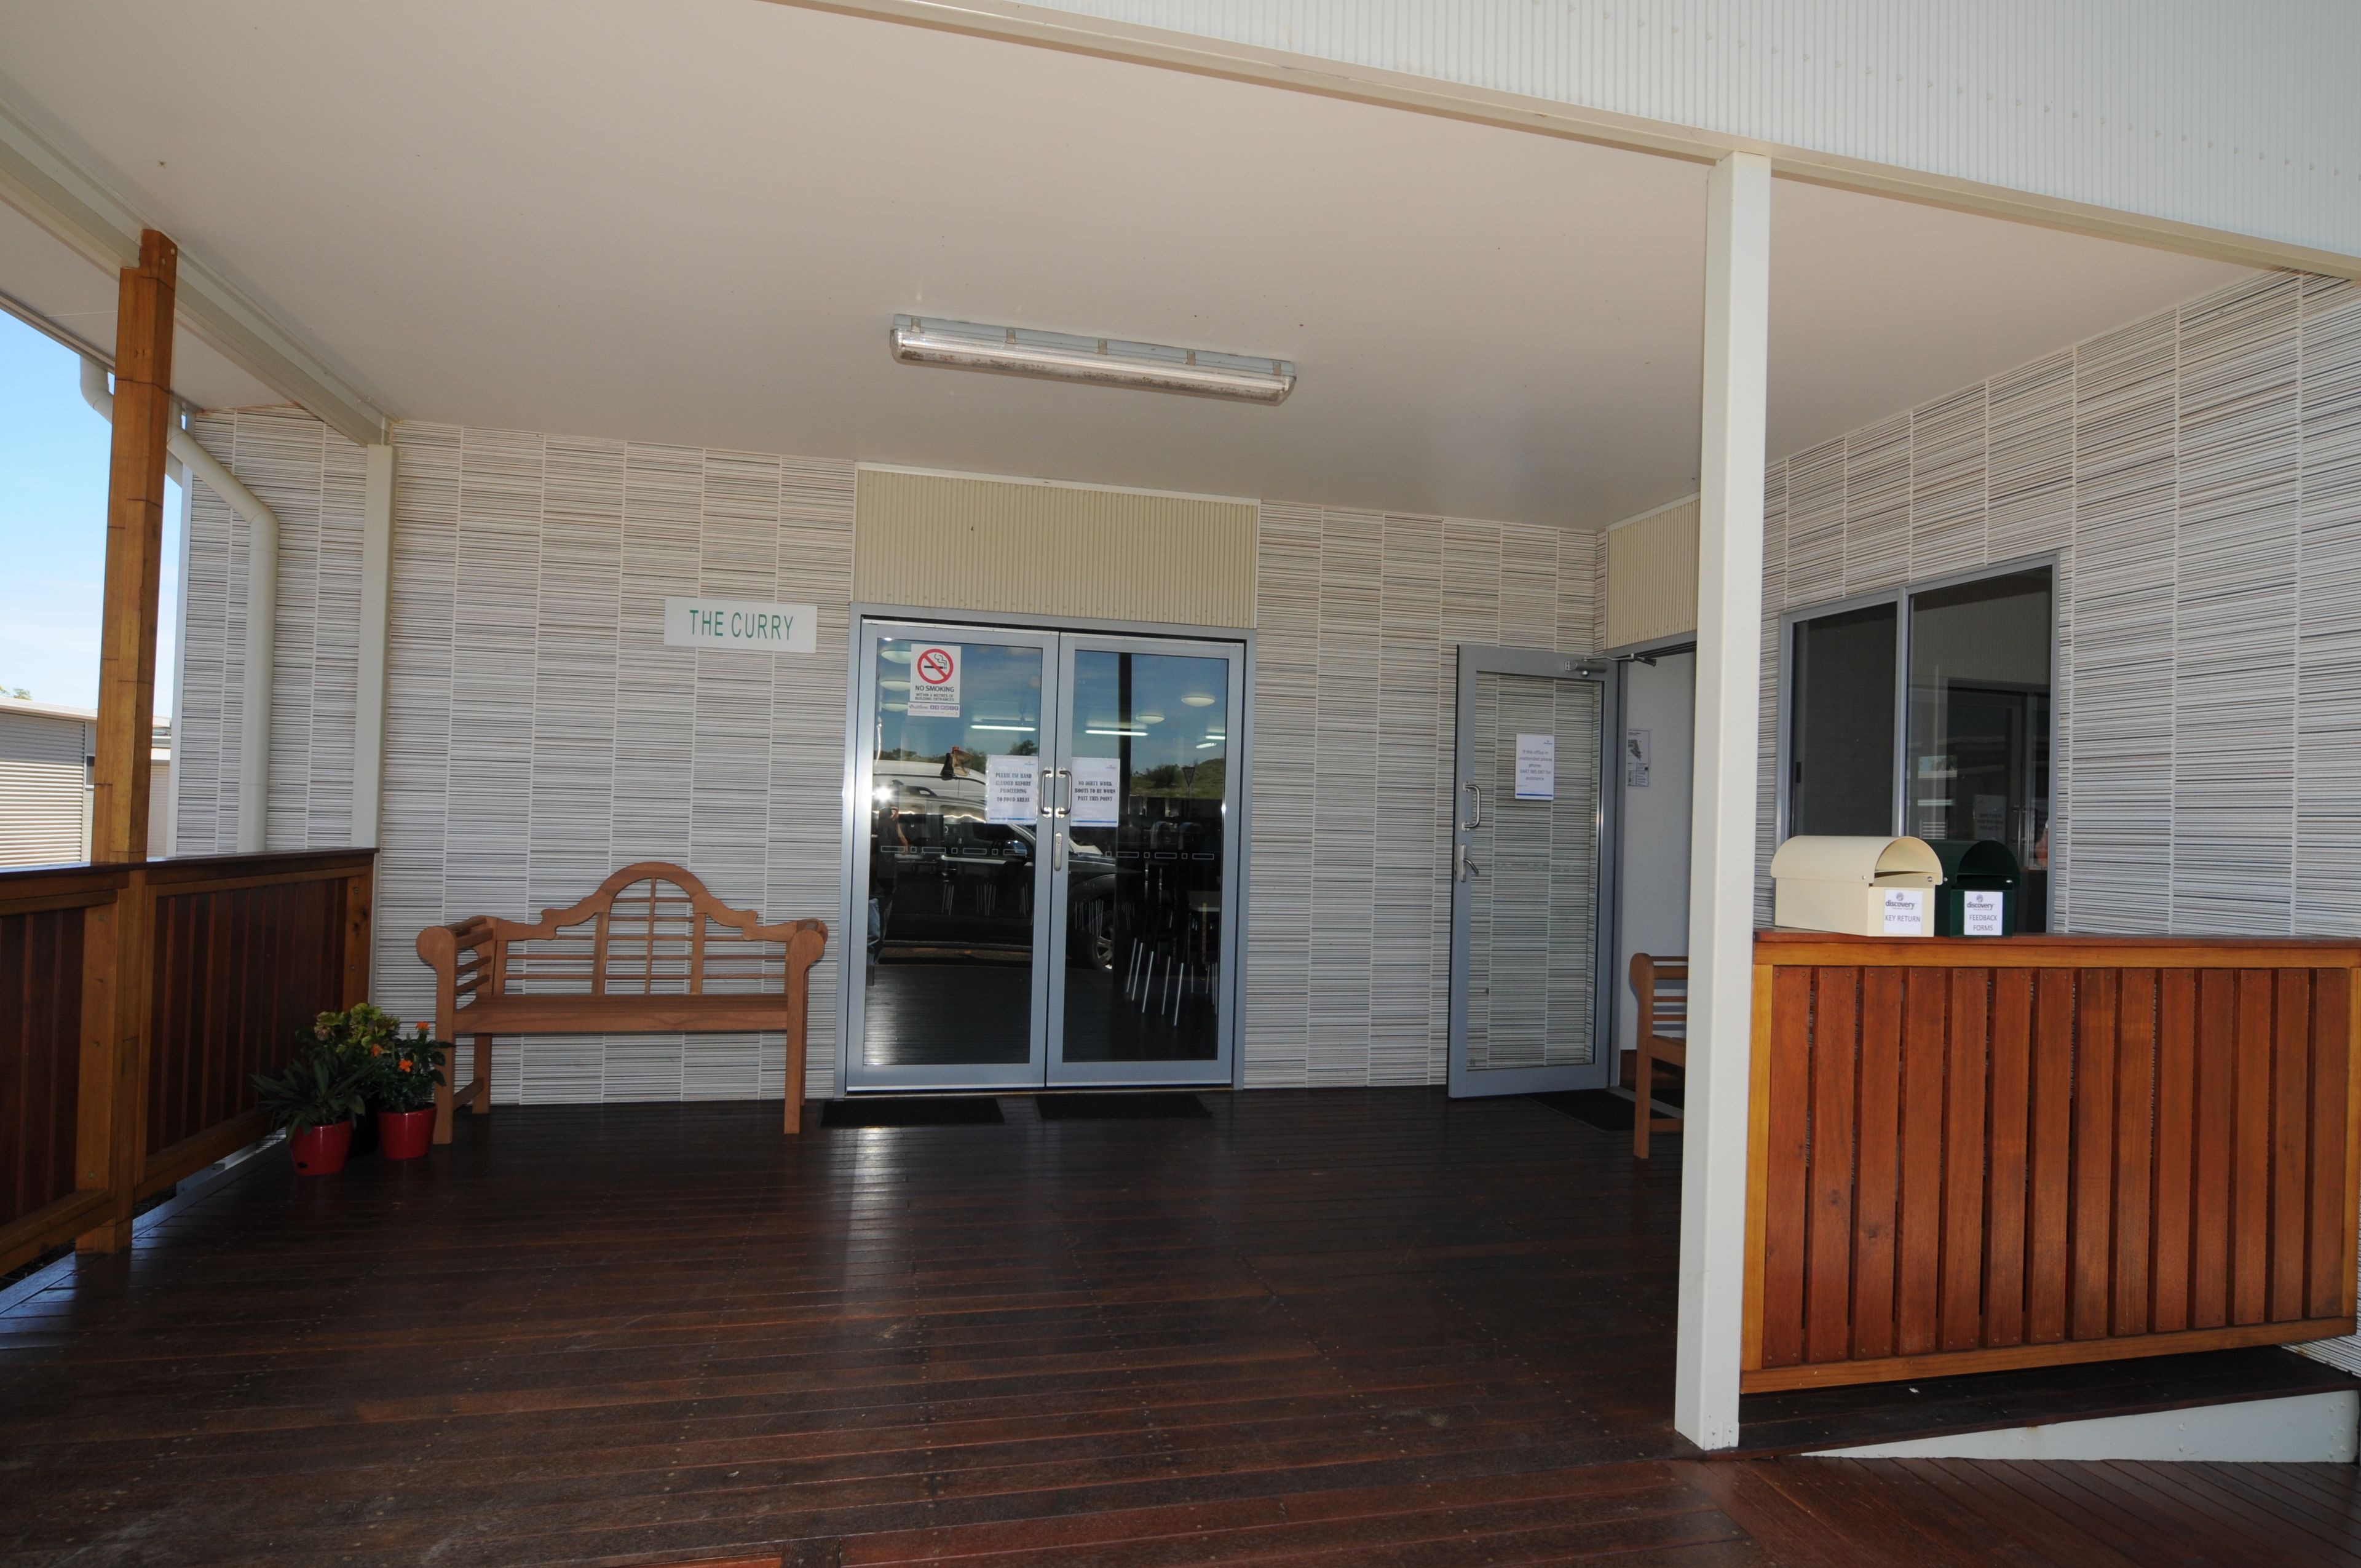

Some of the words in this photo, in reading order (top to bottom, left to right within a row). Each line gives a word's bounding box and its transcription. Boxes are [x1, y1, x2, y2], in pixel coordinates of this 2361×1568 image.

[690, 609, 724, 636] THE
[732, 612, 793, 640] CURRY
[1885, 900, 1915, 910] discovery
[1967, 901, 1993, 910] discovery
